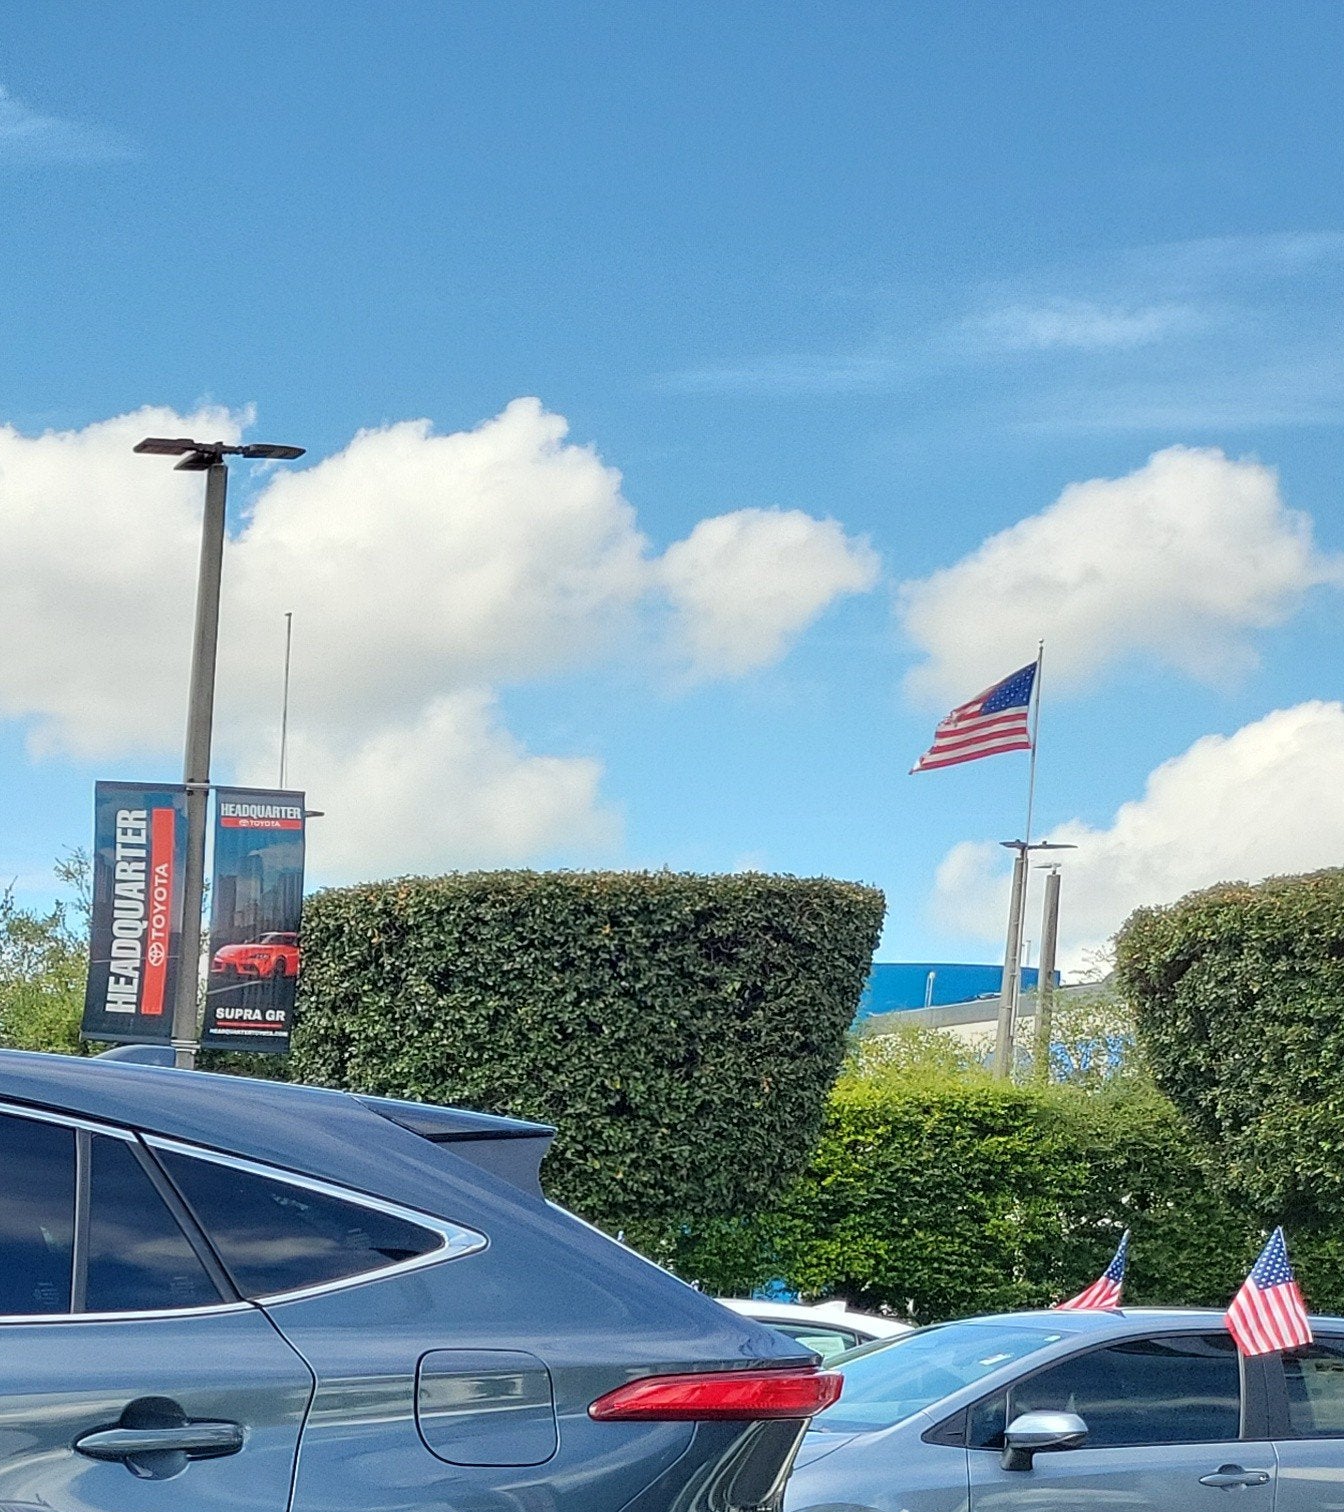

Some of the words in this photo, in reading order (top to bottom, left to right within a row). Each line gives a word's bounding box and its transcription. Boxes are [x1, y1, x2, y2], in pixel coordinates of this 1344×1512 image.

[221, 803, 302, 819] HEADQUARTER
[105, 809, 148, 1014] HEADQUARTER
[152, 863, 169, 941] TOYOTA
[215, 1007, 263, 1020] SUPRA
[265, 1009, 286, 1022] GR
